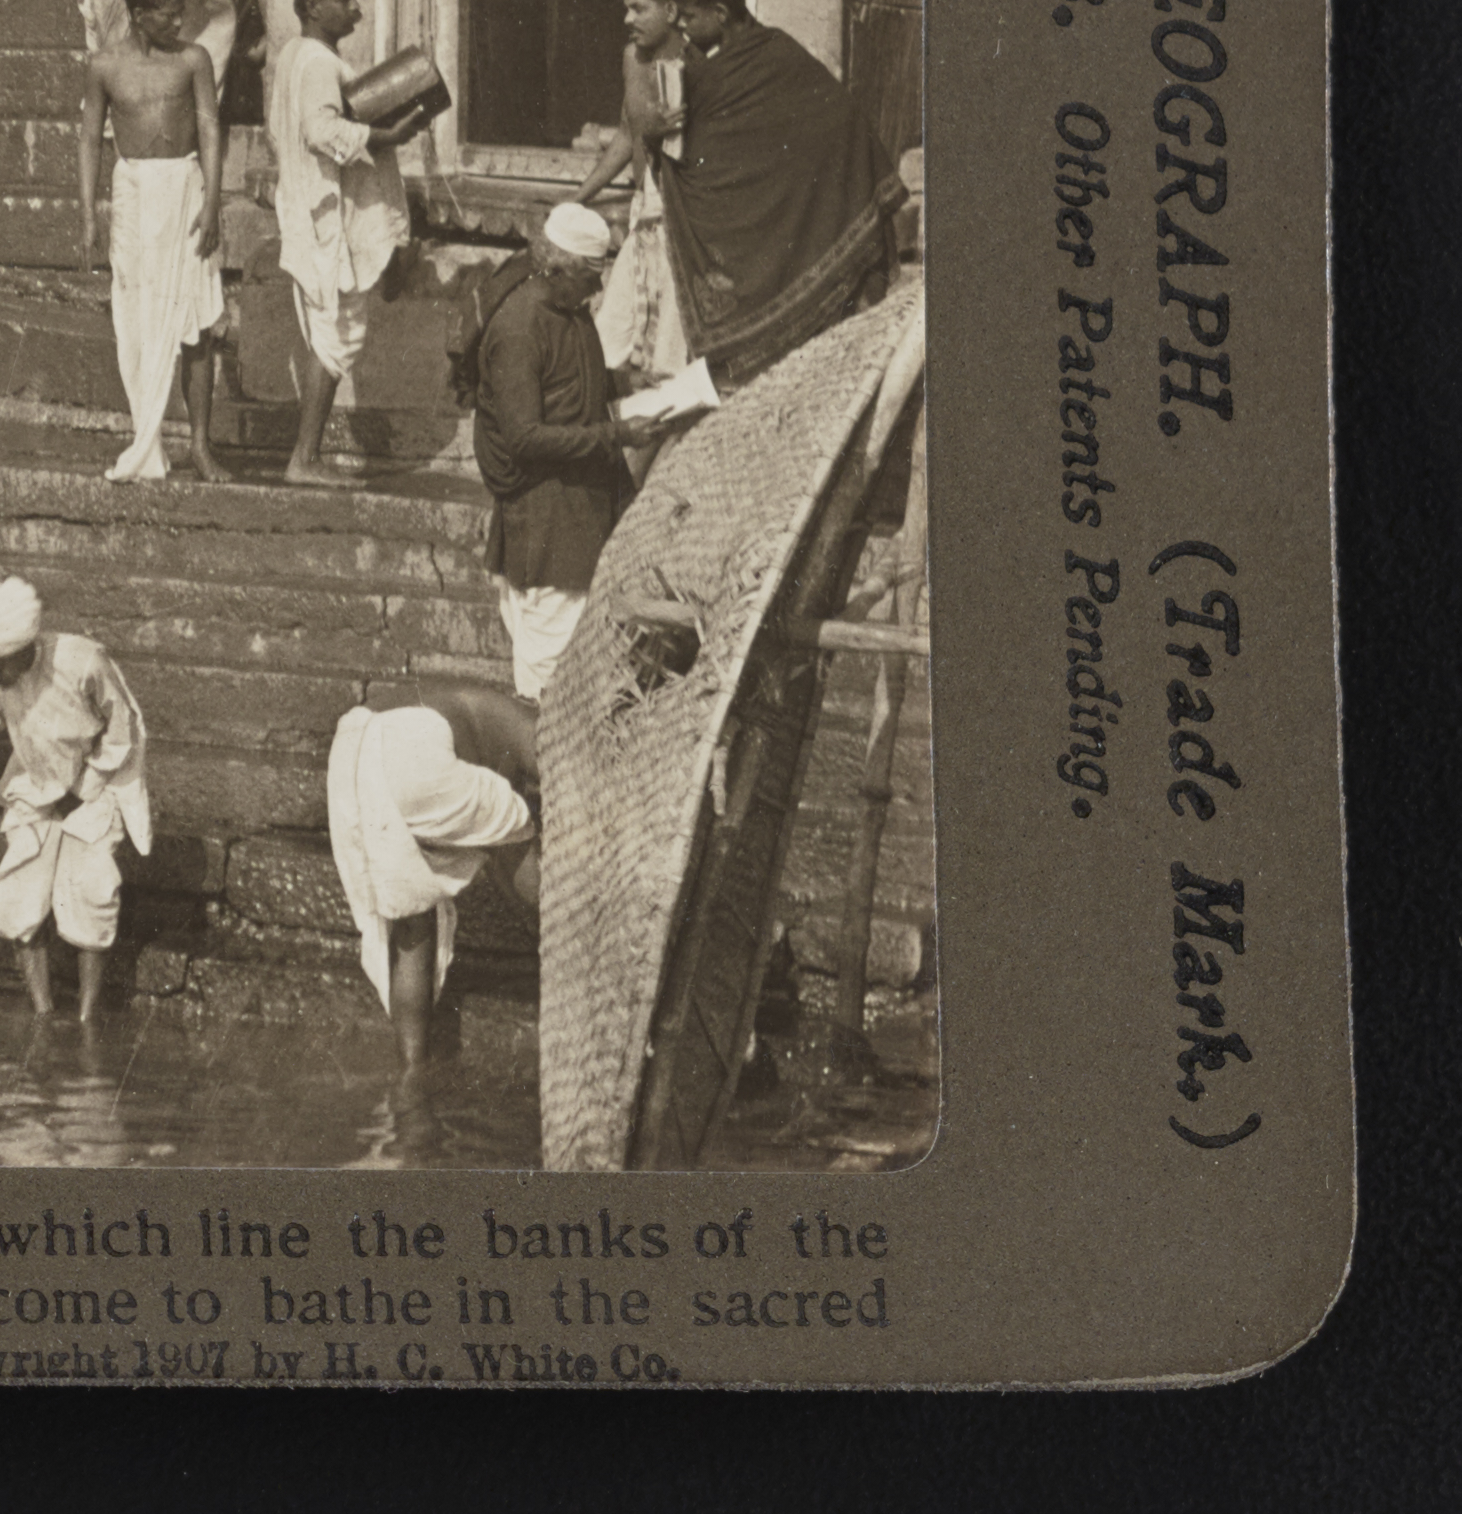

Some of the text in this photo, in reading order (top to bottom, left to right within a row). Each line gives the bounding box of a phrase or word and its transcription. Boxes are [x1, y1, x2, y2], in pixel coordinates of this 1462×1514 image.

[1054, 102, 1112, 269] Other
[1057, 288, 1117, 528] Patents
[1056, 549, 1123, 820] Pending.
[1148, 540, 1243, 822] (Trade
[1168, 862, 1262, 1150] Mark.)
[162, 1282, 223, 1325] to
[260, 1276, 433, 1325] bathe
[457, 1276, 515, 1325] in
[549, 1278, 651, 1326] the
[693, 1278, 892, 1328] sacred
[199, 1208, 311, 1259] line
[347, 1210, 446, 1259] the
[482, 1207, 671, 1259] banks
[693, 1207, 753, 1258] of
[789, 1210, 889, 1260] the
[131, 1340, 230, 1378] 1907
[250, 1340, 304, 1378] by
[321, 1341, 379, 1379] H.
[397, 1342, 445, 1379] C.
[461, 1343, 599, 1381] White
[610, 1343, 682, 1381] Co.
